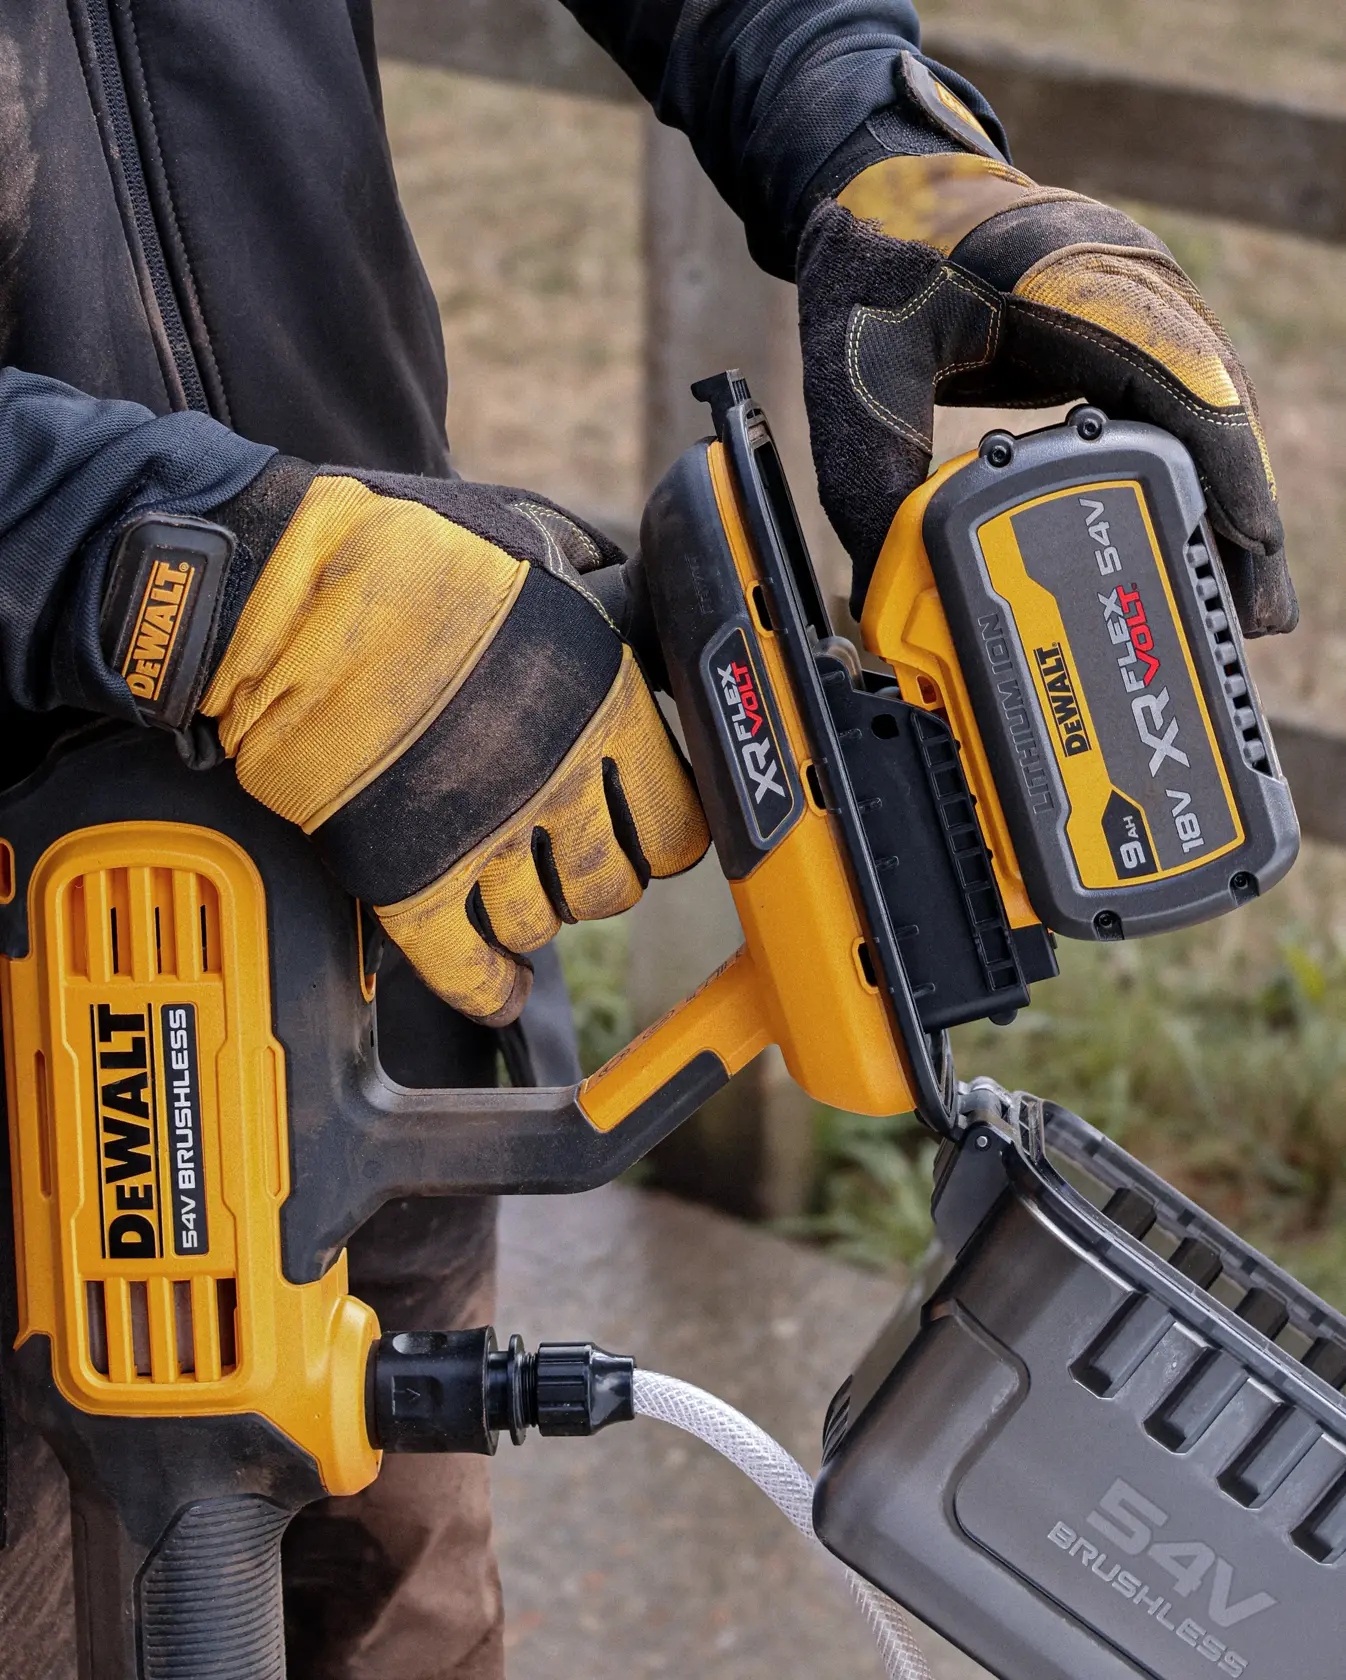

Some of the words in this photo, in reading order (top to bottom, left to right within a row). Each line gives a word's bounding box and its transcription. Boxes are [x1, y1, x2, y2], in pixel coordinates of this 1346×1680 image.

[1079, 498, 1123, 576] 54V
[126, 561, 188, 700] DEWALT
[977, 613, 1014, 675] ION
[1097, 588, 1146, 693] FLEX
[1116, 584, 1161, 687] VOLT
[717, 663, 752, 741] FLEX
[731, 661, 763, 736] VOLT
[996, 678, 1055, 815] LITHIUM
[1035, 644, 1090, 757] DEWALT
[1131, 686, 1190, 777] XR
[742, 737, 786, 804] XR
[1166, 789, 1205, 853] 18V
[97, 1003, 157, 1259] DEWALT
[168, 1008, 197, 1190] BRUSHLESS
[181, 1194, 199, 1249] 54V
[1046, 1520, 1249, 1679] BRUSHLESS
[1085, 1476, 1279, 1627] 54V
